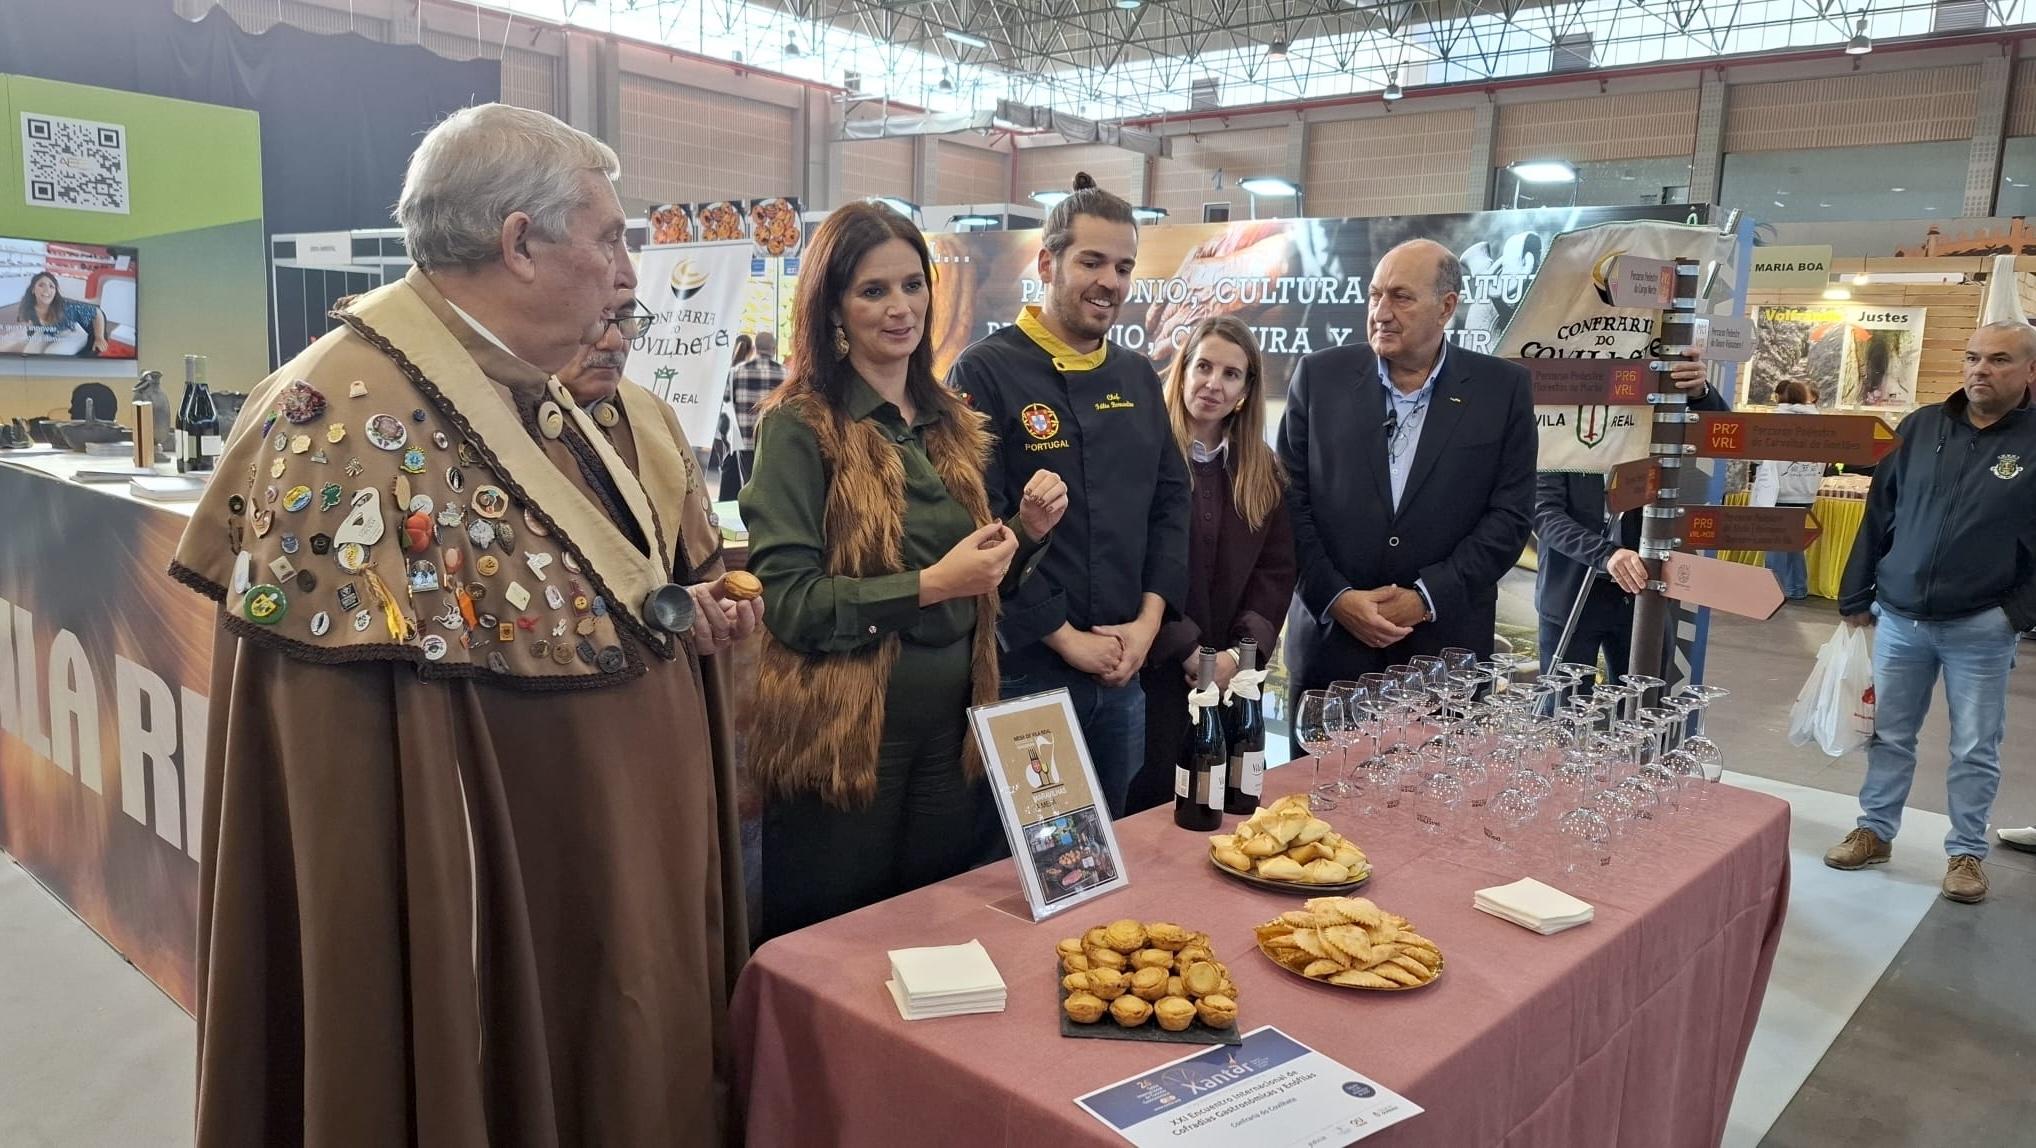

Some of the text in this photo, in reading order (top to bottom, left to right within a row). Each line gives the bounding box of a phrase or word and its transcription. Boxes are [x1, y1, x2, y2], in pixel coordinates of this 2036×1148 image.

[1755, 262, 1824, 272] MARIA BOA
[1214, 277, 1365, 304] CULTURA
[1459, 274, 1536, 304] ATU
[1858, 312, 1909, 324] Justes
[1594, 335, 1615, 346] DO
[1615, 370, 1637, 381] PR6
[1615, 384, 1635, 395] VRL
[672, 393, 699, 404] REAL
[1611, 415, 1635, 427] REAL
[1713, 423, 1738, 434] PR7
[1025, 440, 1069, 452] PORTUGAL
[1712, 437, 1736, 449] VRL
[1693, 518, 1713, 529] PR9
[0, 596, 103, 796] ILA
[1181, 1061, 1254, 1095] Xantar
[1188, 1097, 1233, 1119] Encuentro
[1232, 1074, 1287, 1100] Internacional
